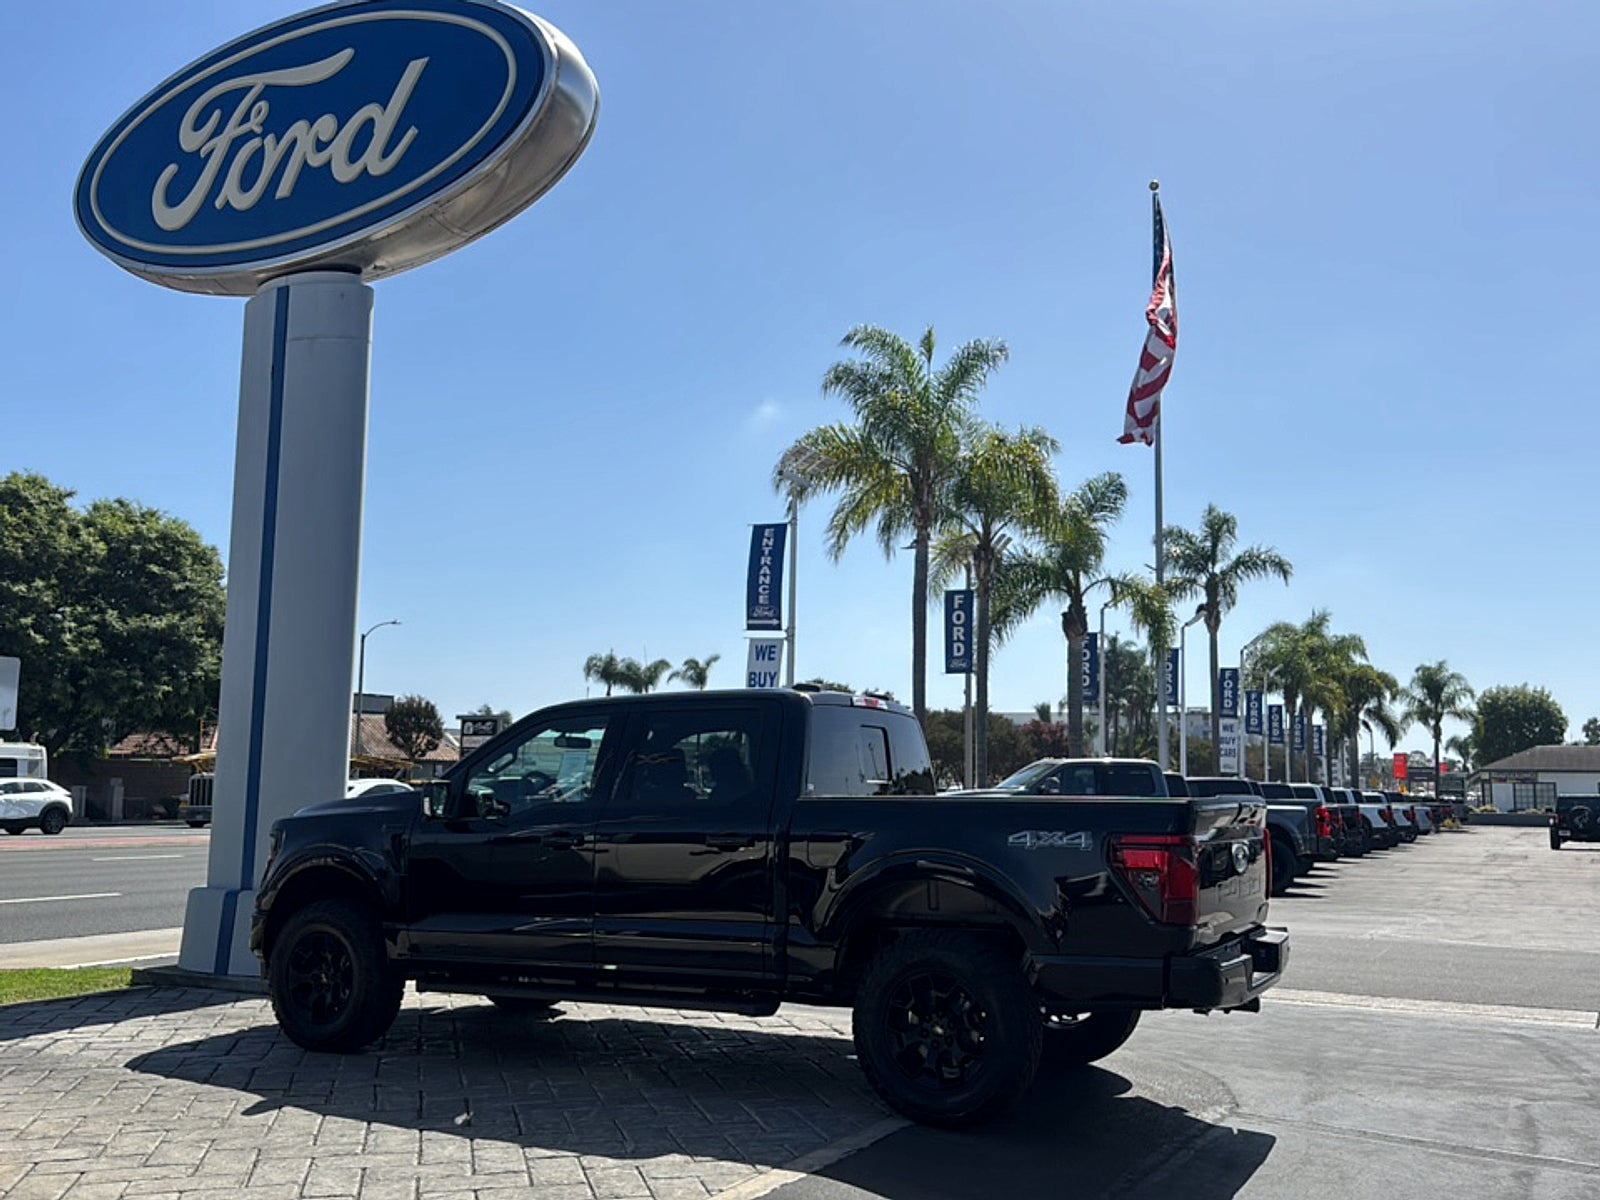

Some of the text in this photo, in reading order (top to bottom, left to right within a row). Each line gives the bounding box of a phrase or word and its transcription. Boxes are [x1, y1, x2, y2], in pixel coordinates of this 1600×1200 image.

[152, 48, 429, 231] Ford
[758, 528, 775, 604] ENTRANCE
[952, 595, 965, 656] FORD
[755, 645, 776, 661] WE
[750, 672, 777, 687] BUY
[1223, 670, 1233, 708] FORD
[1250, 693, 1258, 726] FORD
